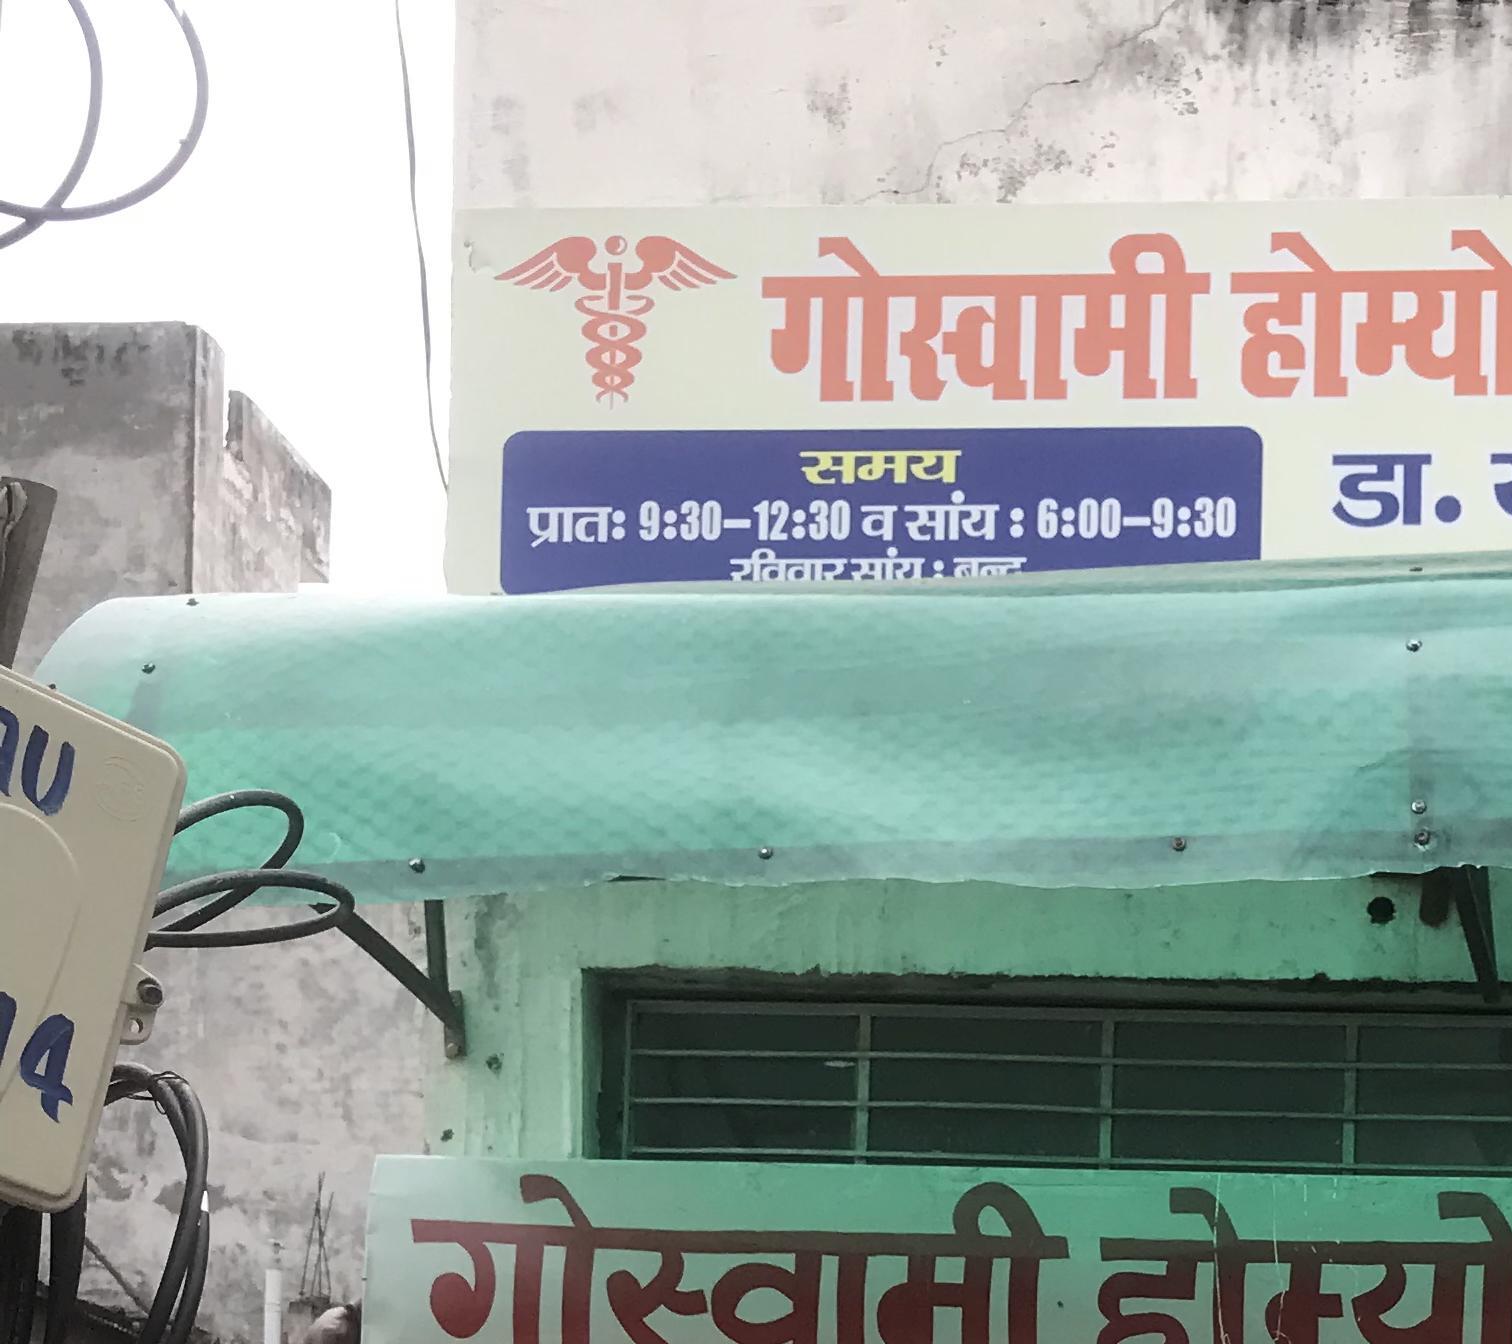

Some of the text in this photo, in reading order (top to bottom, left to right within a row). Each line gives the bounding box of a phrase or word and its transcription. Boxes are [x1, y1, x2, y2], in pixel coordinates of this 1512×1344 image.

[762, 233, 1211, 402] गोस्वामी
[799, 449, 961, 485] समय
[1332, 453, 1462, 528] डा.
[860, 505, 898, 541] व
